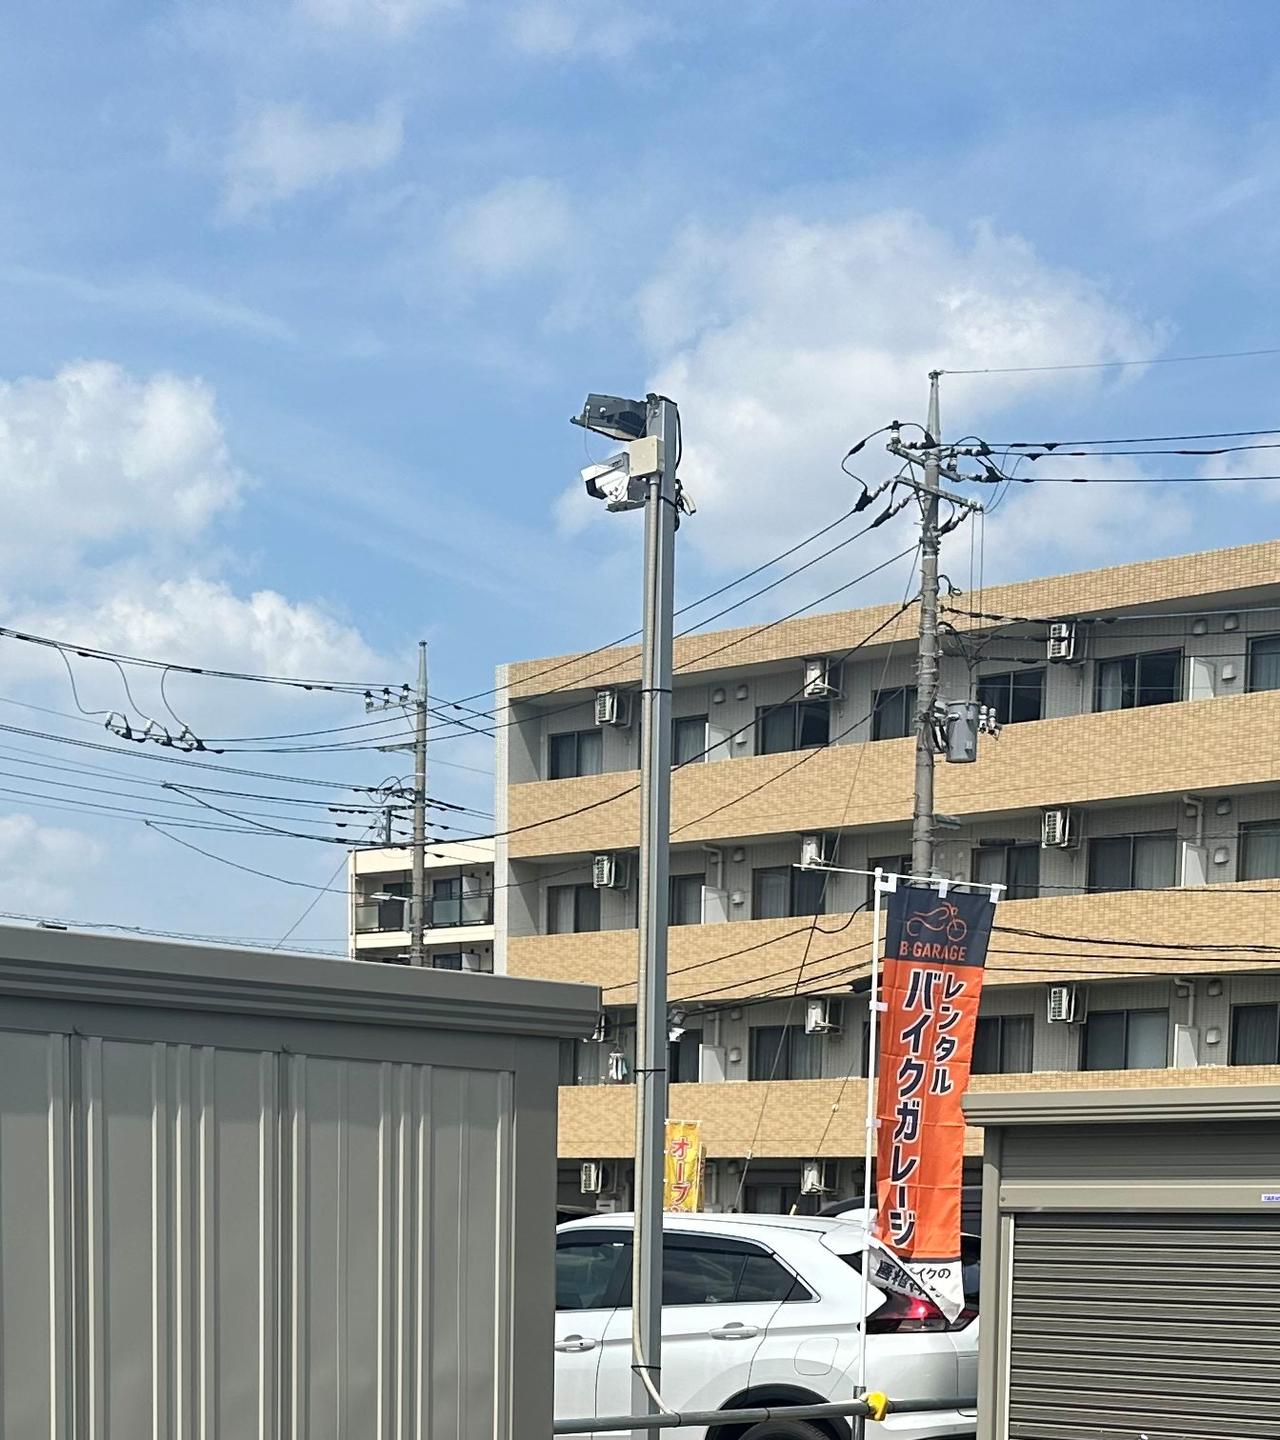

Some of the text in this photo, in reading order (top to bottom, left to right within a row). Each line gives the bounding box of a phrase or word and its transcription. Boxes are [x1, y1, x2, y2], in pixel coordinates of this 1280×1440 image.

[888, 968, 941, 1248] バイクガレージ
[929, 971, 967, 1096] レンタル
